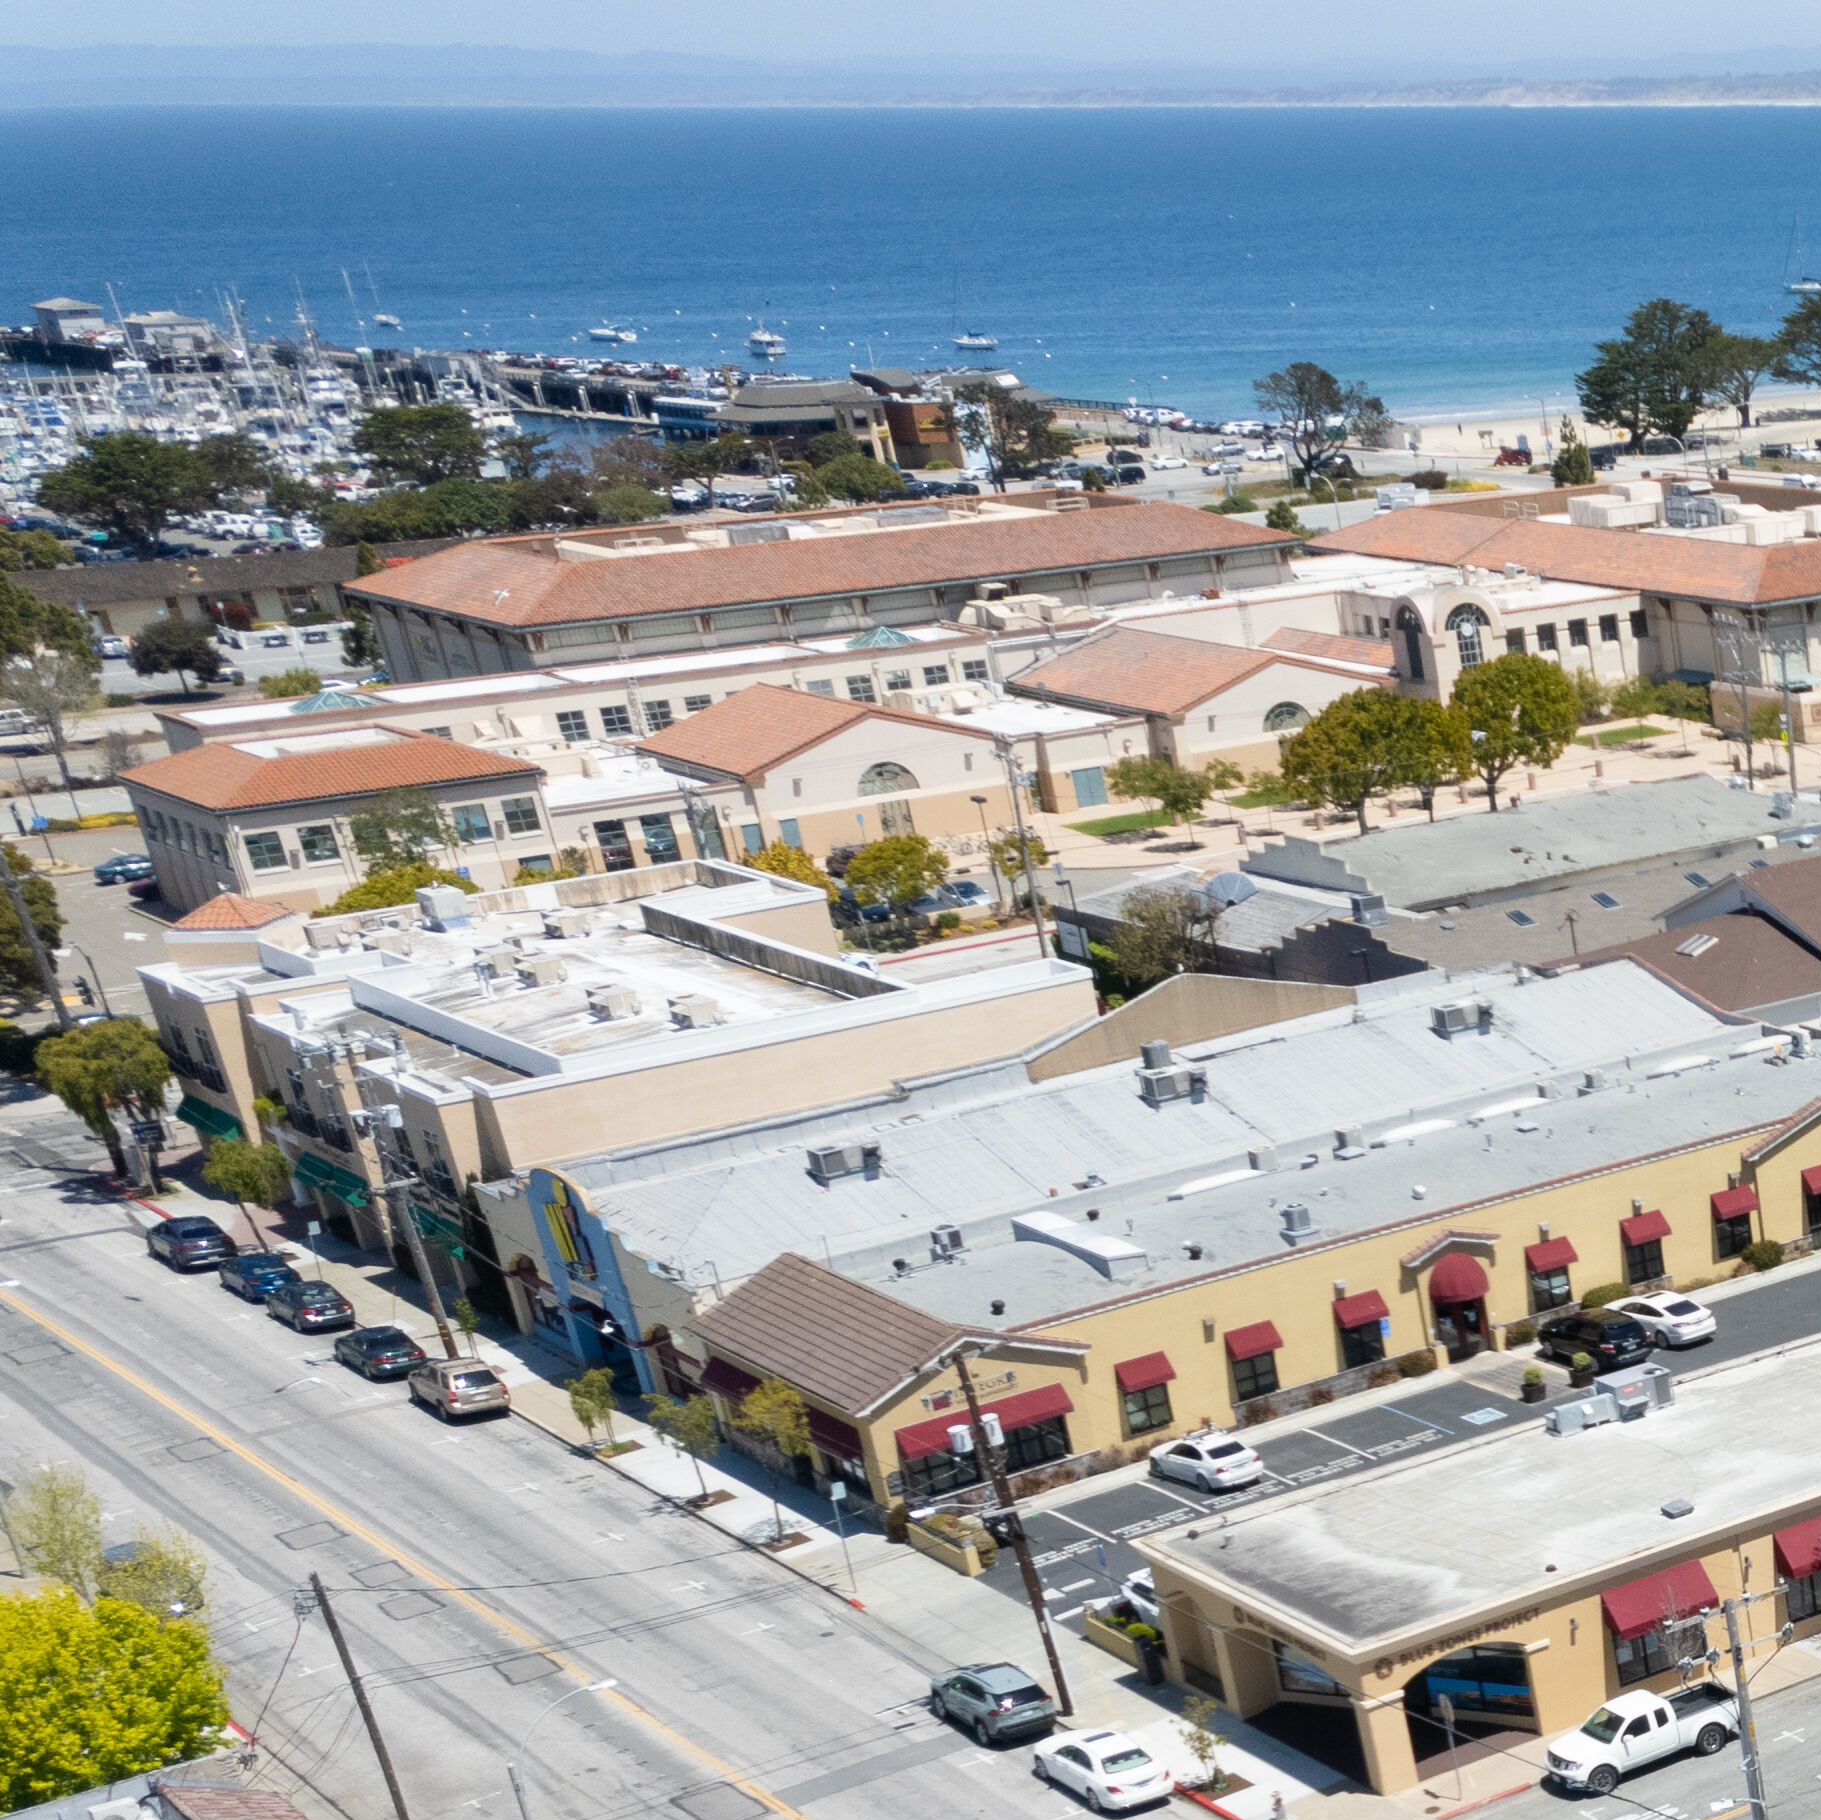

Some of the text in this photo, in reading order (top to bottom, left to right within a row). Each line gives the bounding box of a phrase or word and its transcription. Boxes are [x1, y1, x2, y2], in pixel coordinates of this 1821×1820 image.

[1400, 1608, 1540, 1666] BLUE ZONES PROJECT
